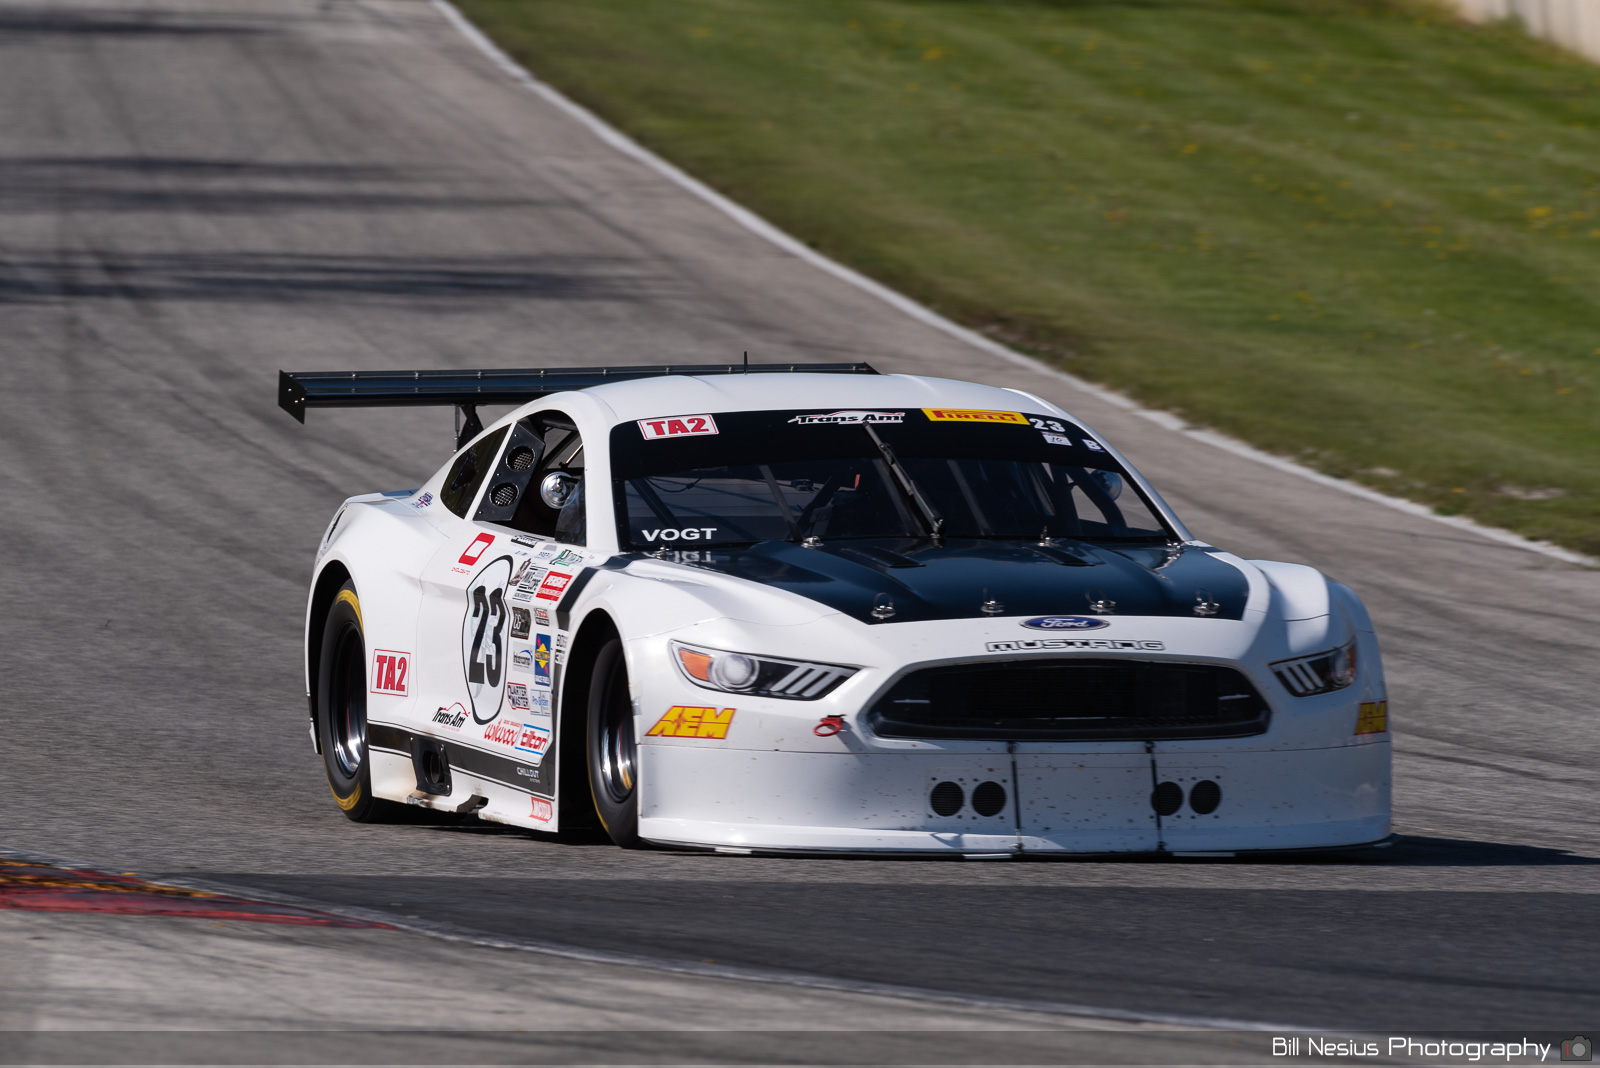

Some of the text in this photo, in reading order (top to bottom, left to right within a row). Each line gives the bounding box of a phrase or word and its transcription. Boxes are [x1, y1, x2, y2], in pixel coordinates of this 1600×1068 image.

[798, 413, 902, 423] Trans Am
[931, 410, 1019, 422] PIRELLI
[1029, 418, 1066, 433] 23
[646, 417, 710, 436] TA2
[641, 528, 717, 542] VOGT
[1040, 618, 1090, 628] Ford
[468, 585, 506, 688] 23
[985, 639, 1166, 652] MUSTANG
[375, 654, 407, 692] TA2
[432, 706, 466, 728] Trans Am
[644, 705, 737, 739] AEM
[1352, 700, 1387, 736] AEM
[483, 719, 522, 747] wilwood
[520, 729, 547, 750] tilton
